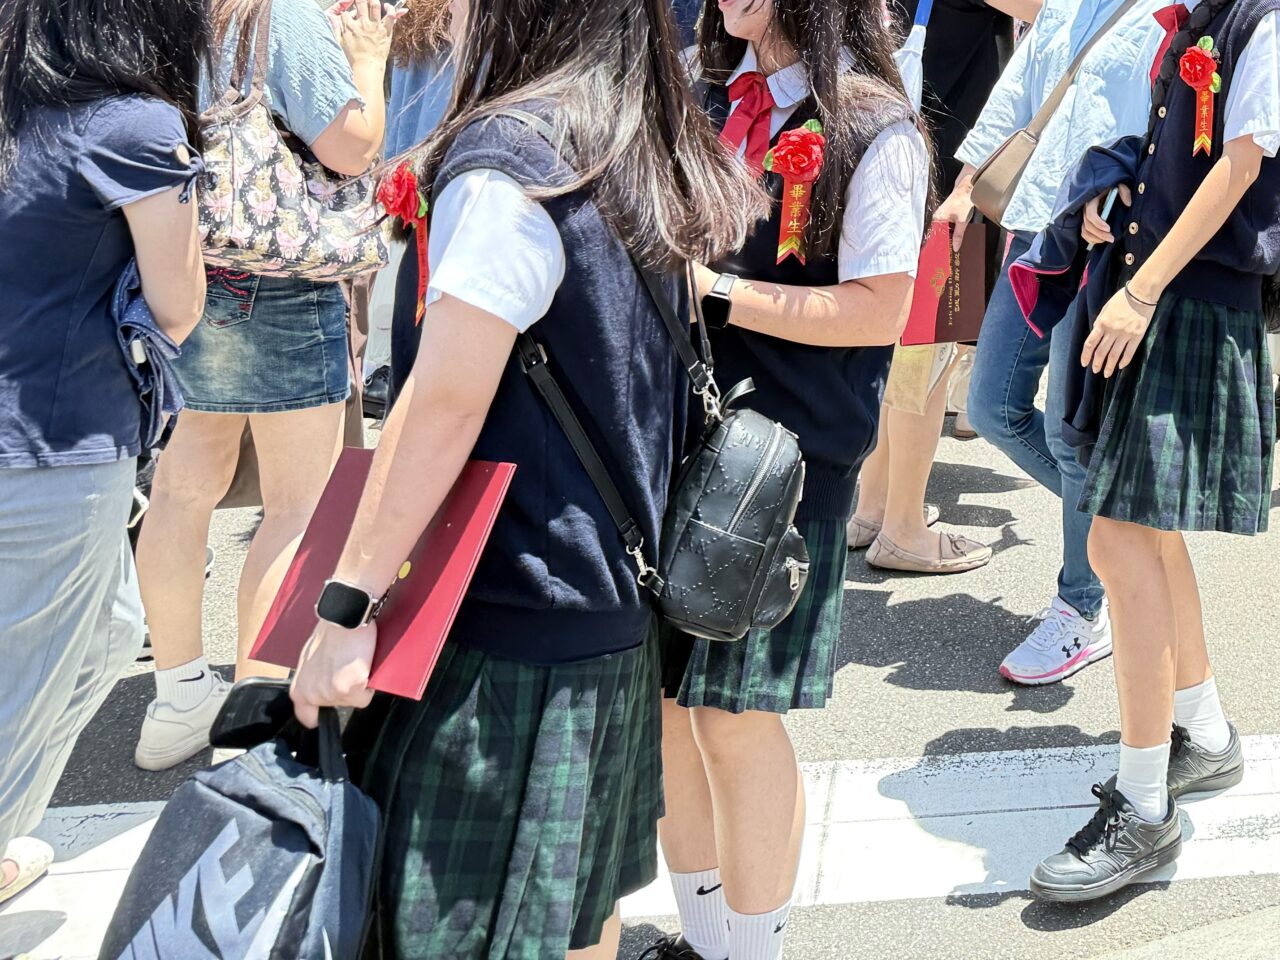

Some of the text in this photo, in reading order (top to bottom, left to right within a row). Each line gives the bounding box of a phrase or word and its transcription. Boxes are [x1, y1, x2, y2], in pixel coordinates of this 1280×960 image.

[787, 183, 806, 233] 畢業生
[117, 817, 266, 960] KE
